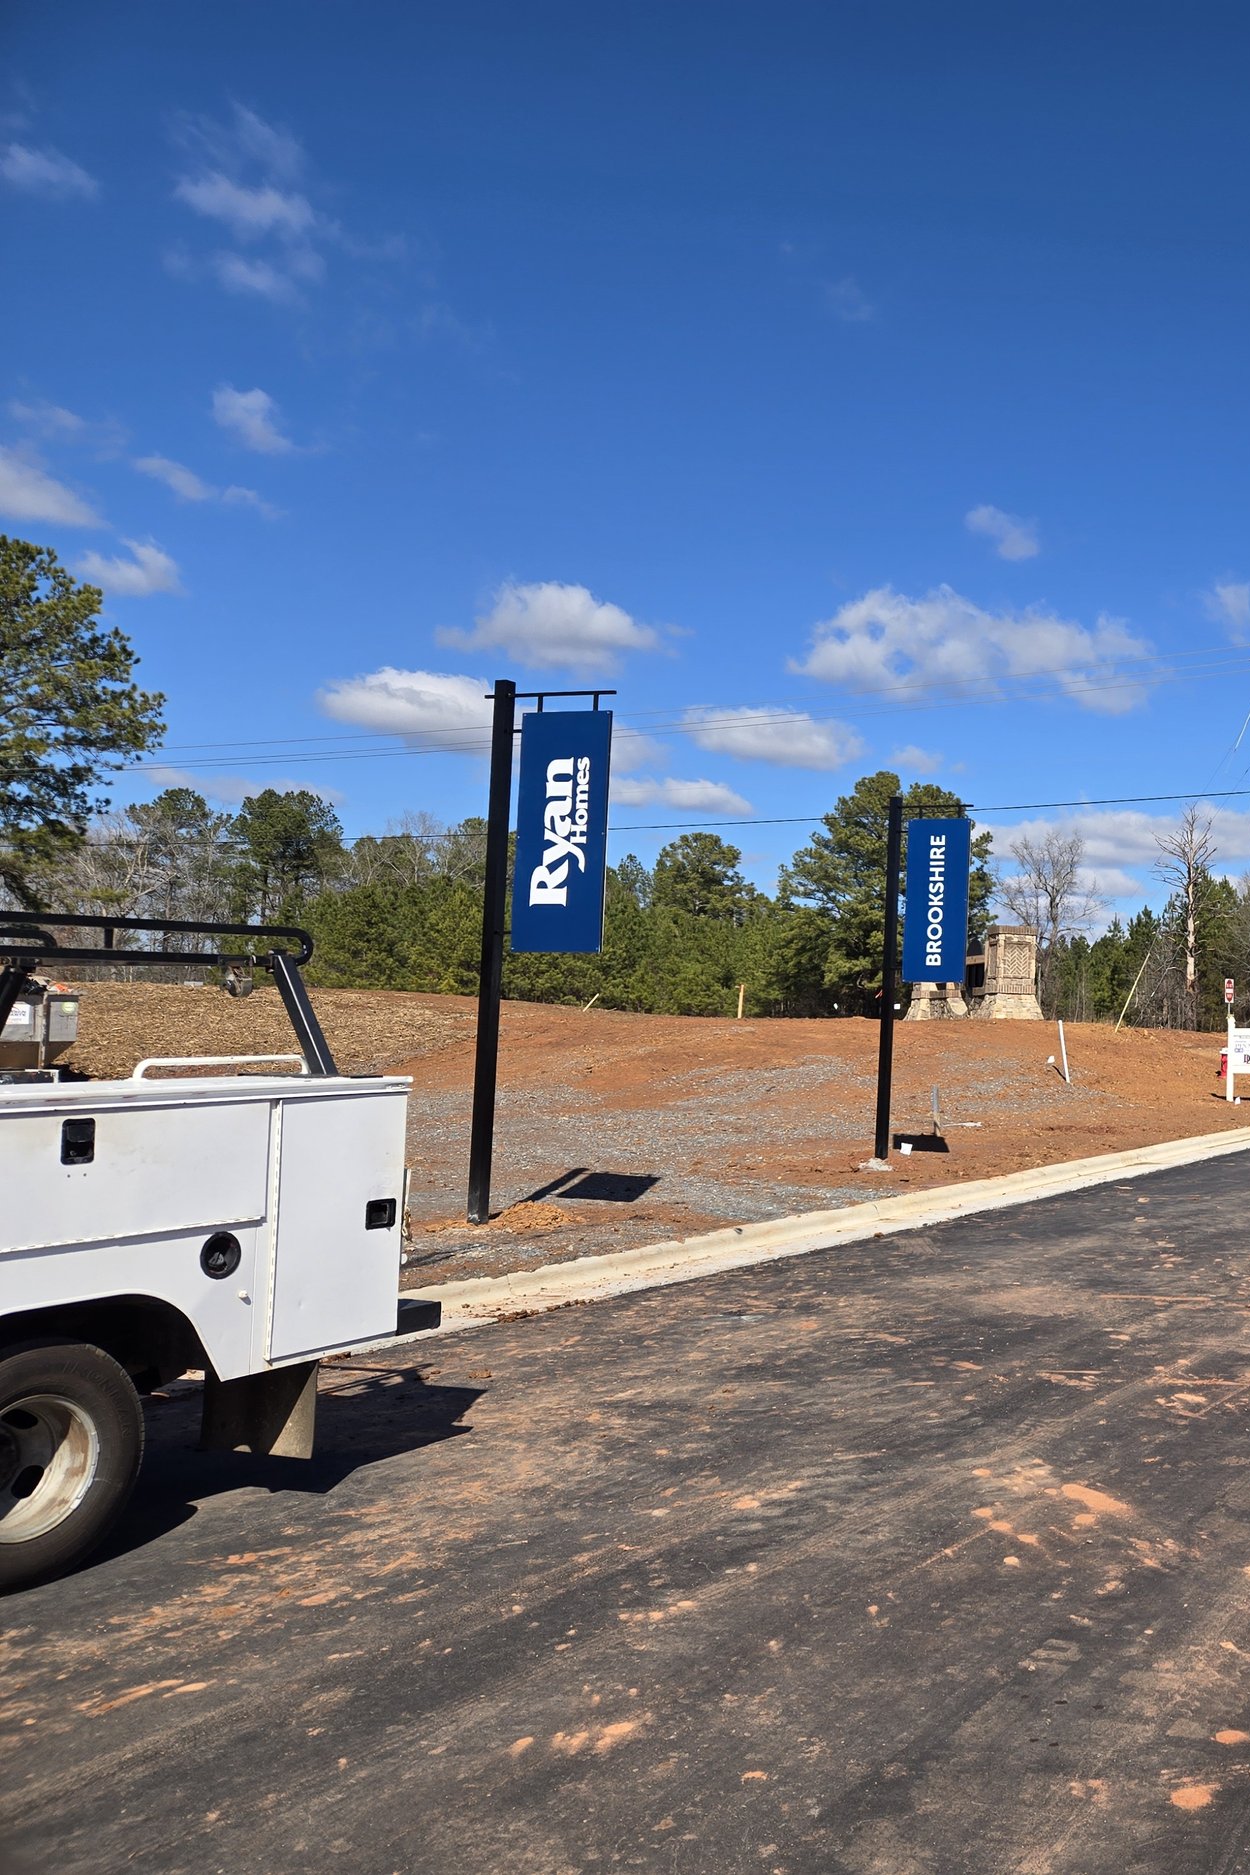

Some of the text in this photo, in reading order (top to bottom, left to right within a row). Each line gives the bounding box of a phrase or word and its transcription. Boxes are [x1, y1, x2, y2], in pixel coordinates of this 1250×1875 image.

[529, 756, 586, 907] Ryan
[570, 756, 590, 844] Homes
[926, 834, 946, 966] BROOKSHIRE
